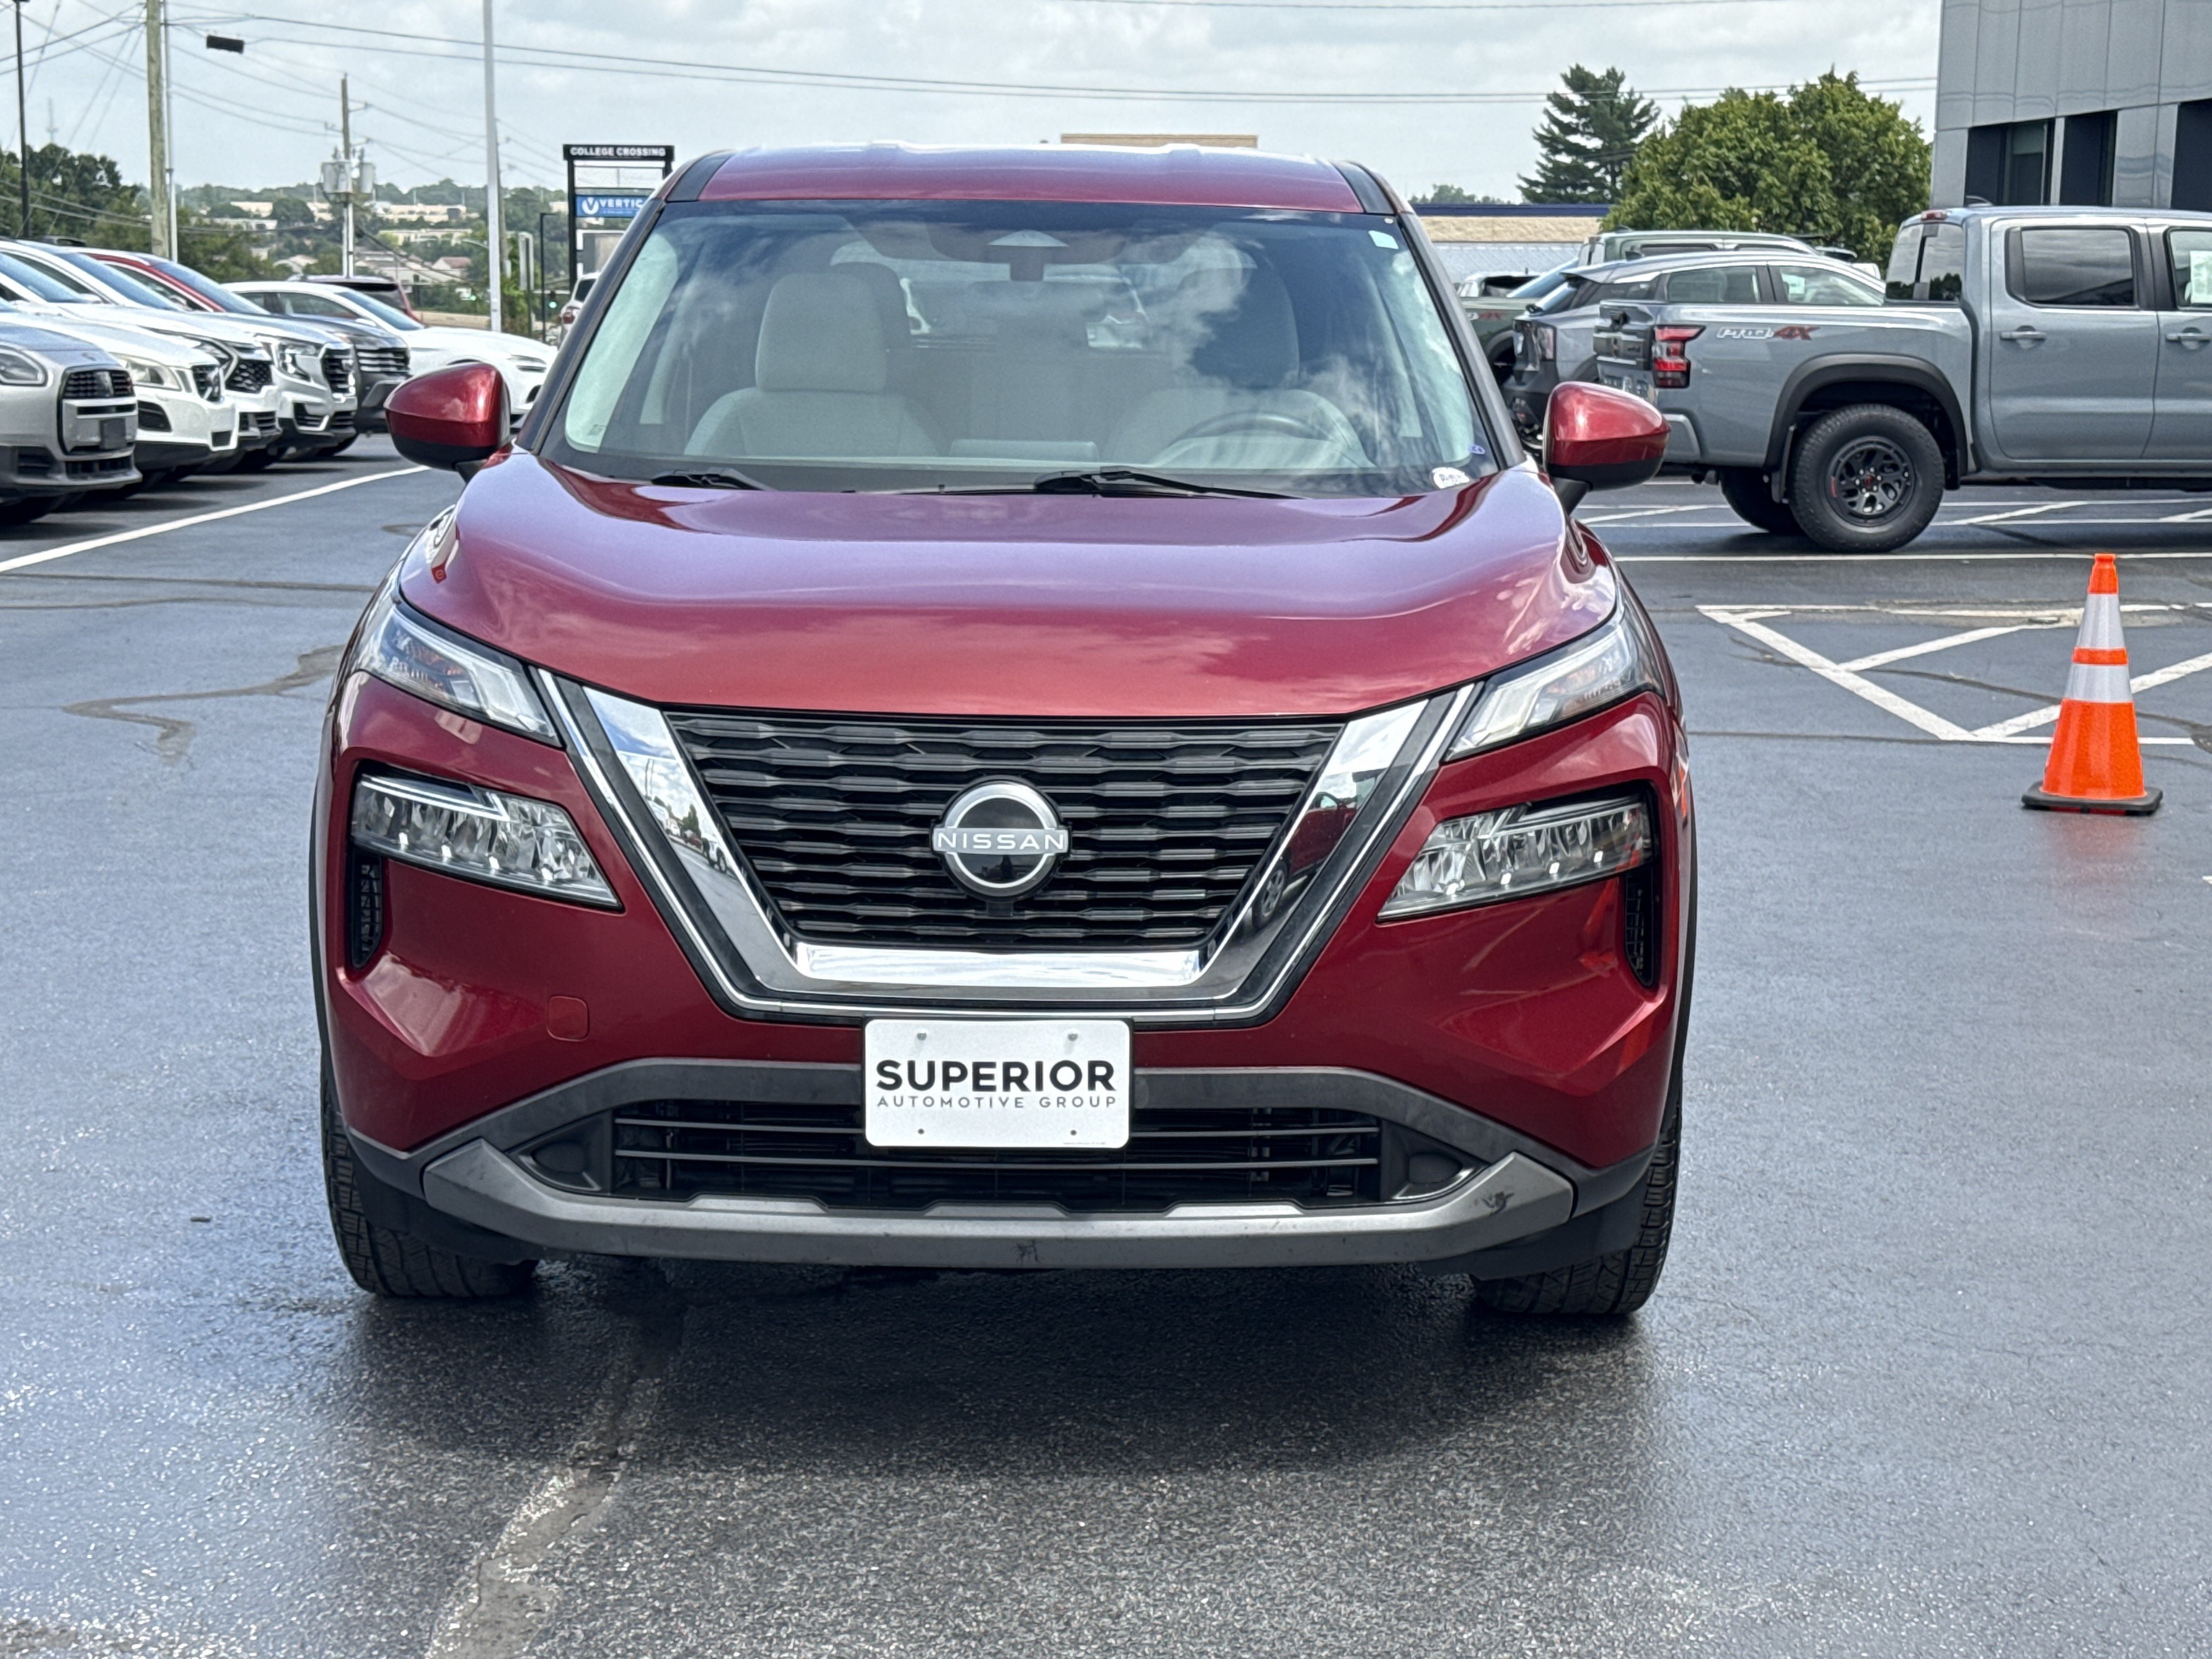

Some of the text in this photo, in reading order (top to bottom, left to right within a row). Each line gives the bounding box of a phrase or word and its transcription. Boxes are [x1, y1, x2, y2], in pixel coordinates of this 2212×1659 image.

[569, 146, 667, 157] COLLEGE CROSSING
[599, 198, 643, 209] VERTIC
[937, 832, 1064, 850] NISSAN
[876, 1059, 1116, 1092] SUPERIOR
[877, 1096, 1116, 1108] AUTOMOTIVE GROUP
